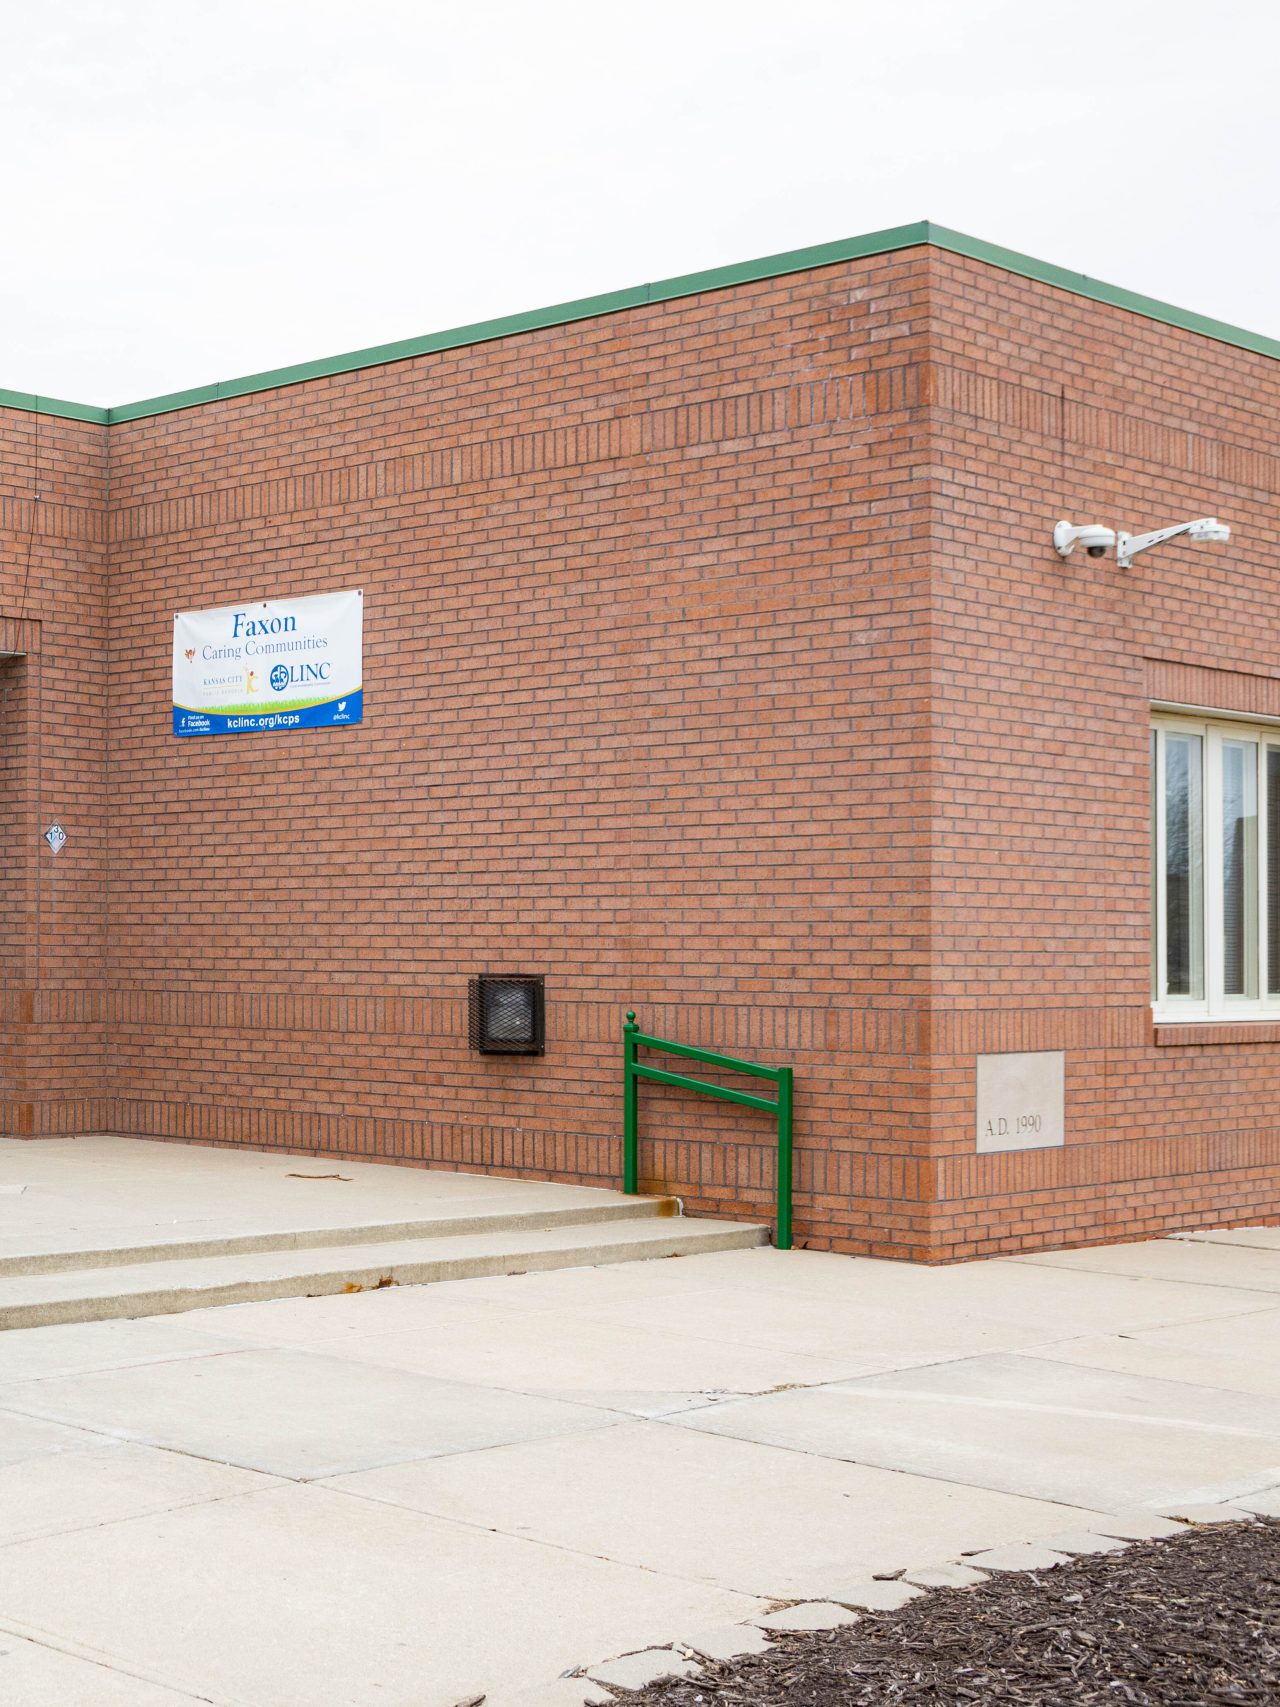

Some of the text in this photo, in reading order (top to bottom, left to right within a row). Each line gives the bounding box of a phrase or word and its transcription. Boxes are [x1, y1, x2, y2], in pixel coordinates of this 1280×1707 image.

[232, 612, 297, 638] Faxon
[202, 635, 328, 661] Caring Communities
[290, 662, 331, 683] LINC
[203, 675, 243, 686] KANSAS CITY
[188, 719, 210, 727] Facebook
[227, 714, 300, 729] kclinc.org/kcps
[49, 832, 64, 840] 1 0
[54, 825, 59, 833] 3
[985, 1114, 1042, 1137] A.D. 1990
